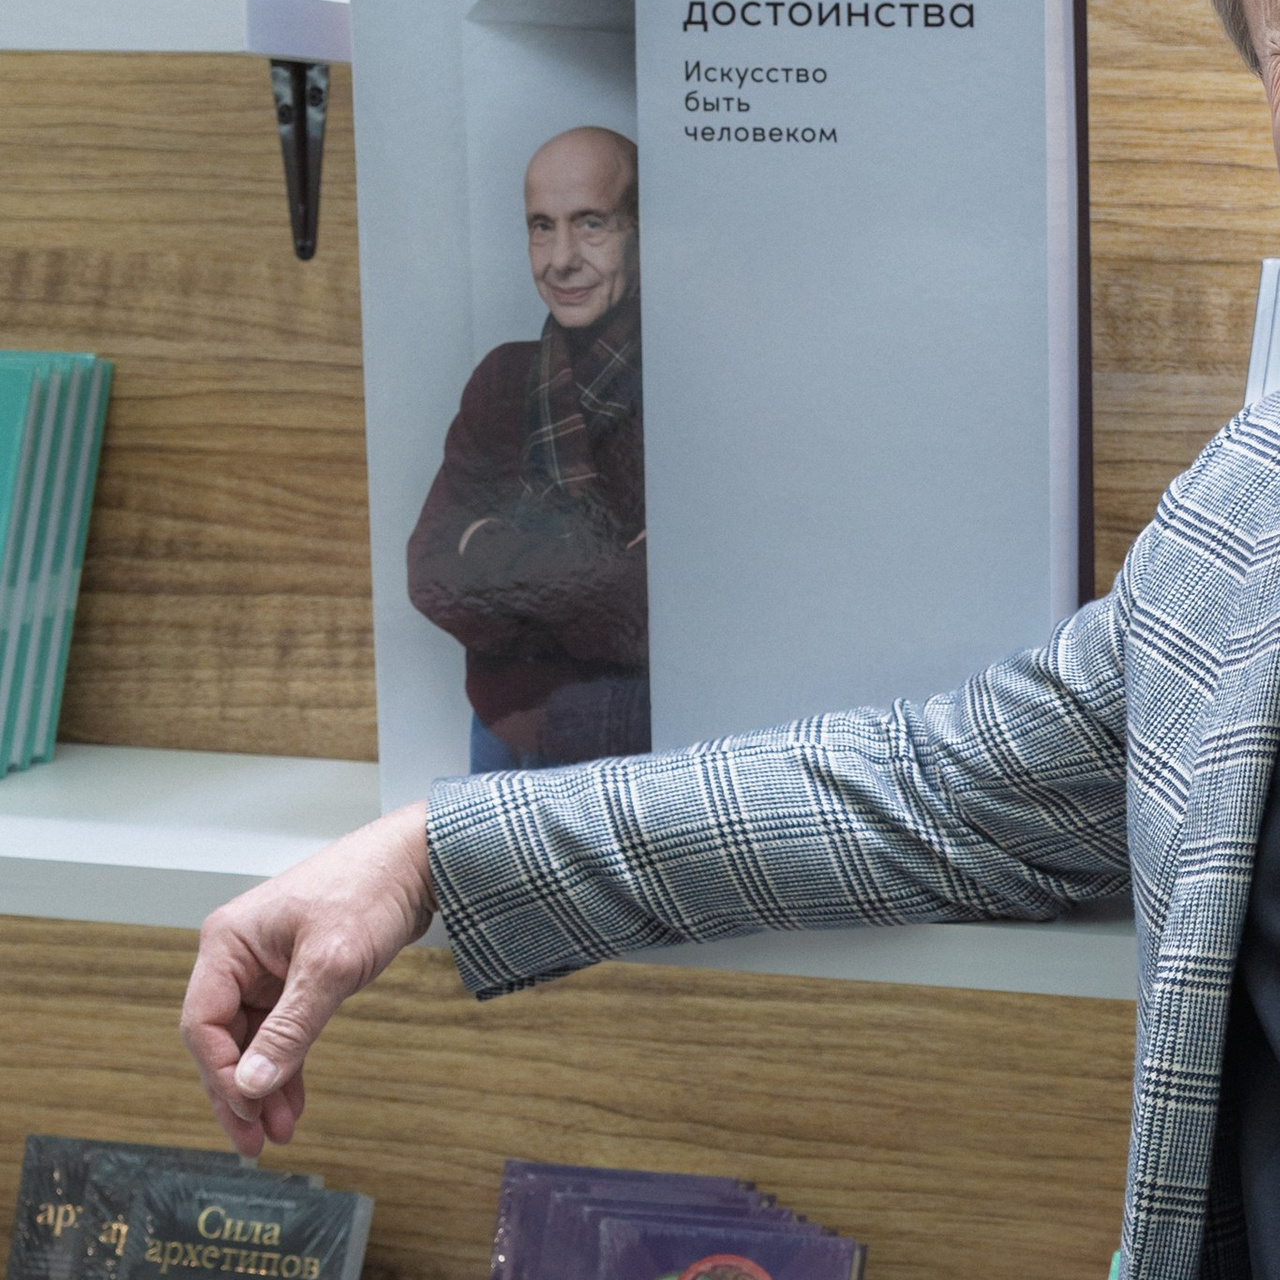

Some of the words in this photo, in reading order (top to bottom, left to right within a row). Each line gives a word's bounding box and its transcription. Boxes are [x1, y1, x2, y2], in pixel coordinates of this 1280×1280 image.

[683, 1, 975, 32] достоинства
[684, 61, 828, 89] Искусство
[684, 91, 751, 113] быть
[684, 126, 838, 143] человеком
[197, 1205, 281, 1246] Сила
[144, 1238, 321, 1280] архетипов
